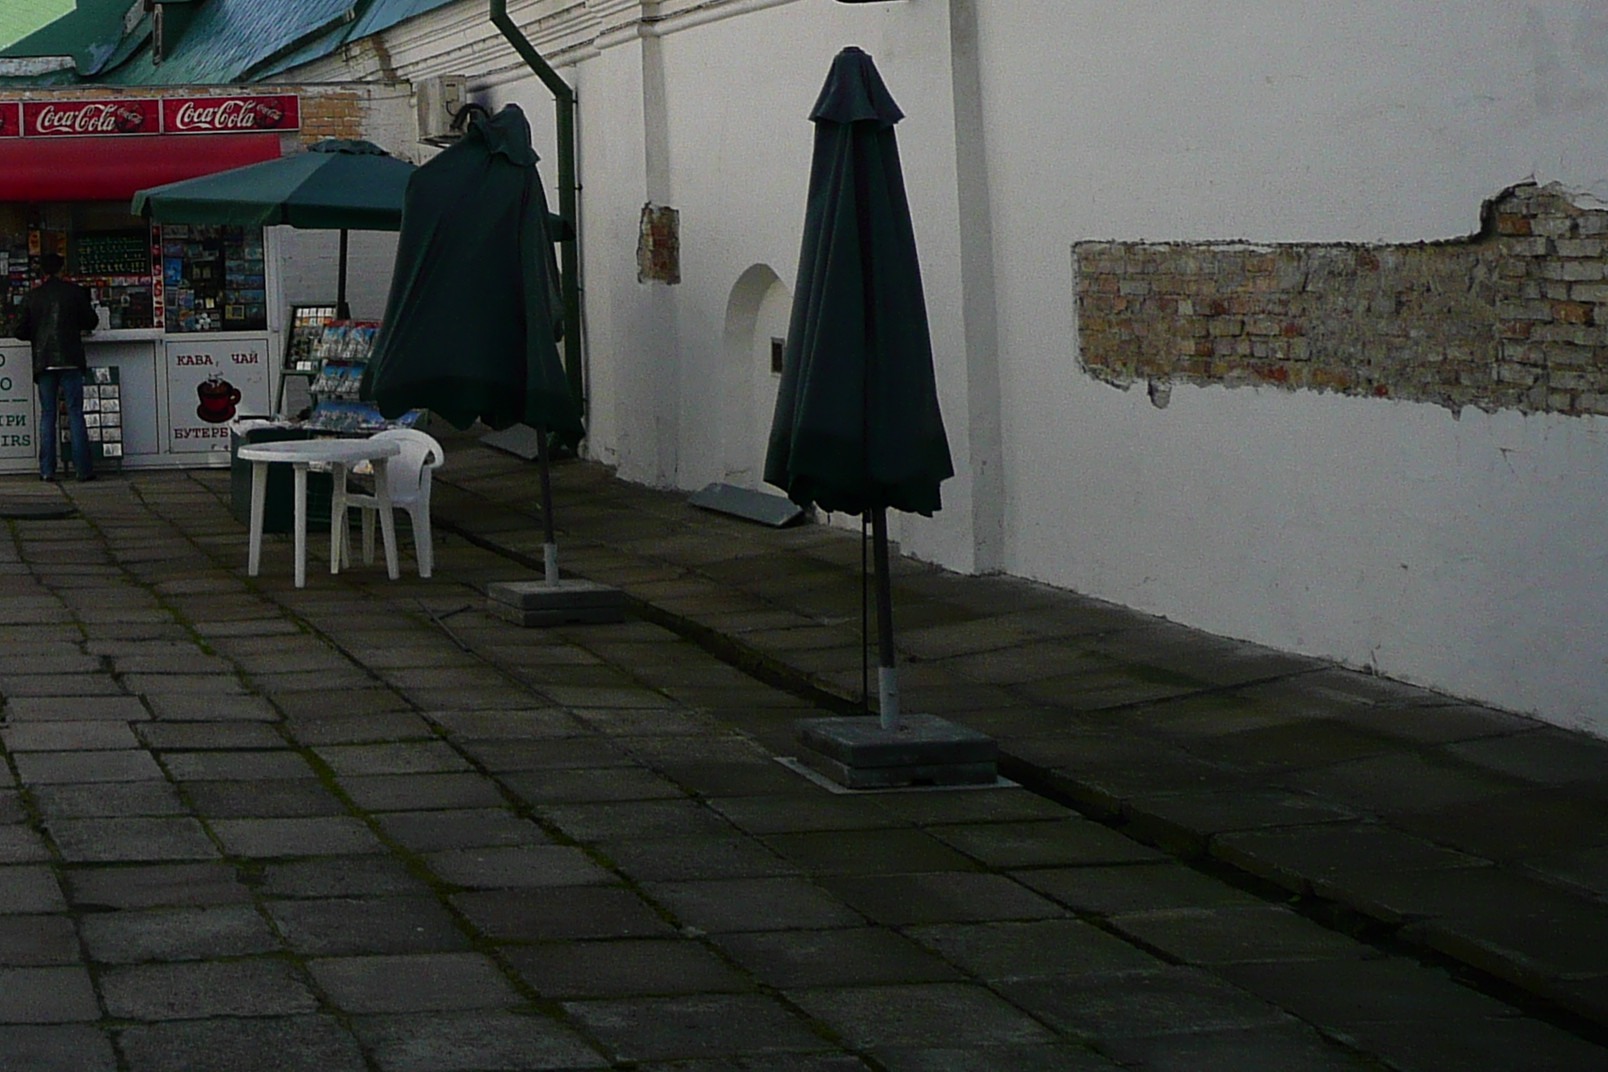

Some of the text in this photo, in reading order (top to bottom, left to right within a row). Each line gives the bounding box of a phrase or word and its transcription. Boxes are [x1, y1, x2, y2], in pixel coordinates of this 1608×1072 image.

[36, 104, 117, 133] Coca-Cola
[176, 100, 256, 129] Coca-Cola
[230, 350, 259, 364] ЧАЙ
[174, 427, 229, 439] БУТЕРБ
